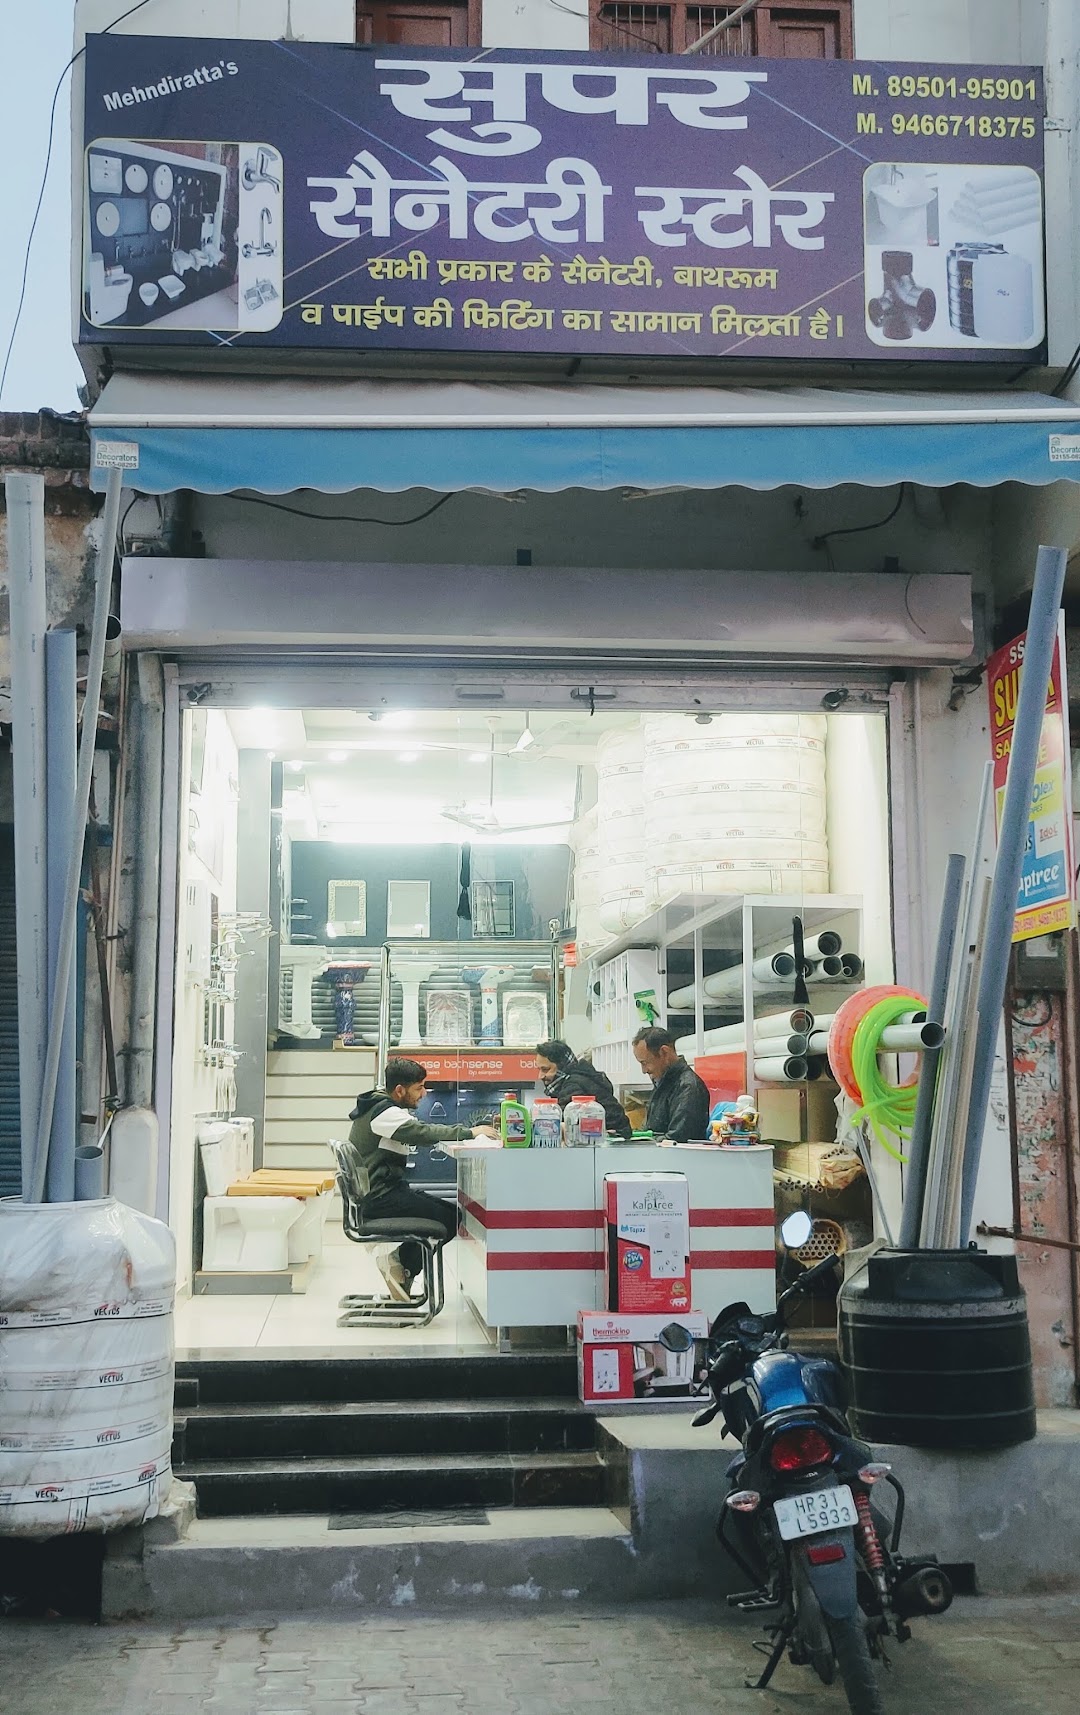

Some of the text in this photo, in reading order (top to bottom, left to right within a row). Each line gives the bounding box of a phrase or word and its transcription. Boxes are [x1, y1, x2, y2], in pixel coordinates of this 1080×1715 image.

[103, 60, 240, 112] Mehndiratta's
[852, 74, 1037, 101] M. 89501-95901
[374, 59, 768, 157] सुपर
[856, 112, 1036, 138] M. 9466718375
[306, 149, 836, 251] सैनेटरी स्टोर
[367, 250, 779, 290] सभी प्रकार के सैनेटरी, बाथरूम
[301, 303, 323, 325] व
[331, 296, 405, 330] पाईप
[413, 297, 454, 328] की
[463, 299, 555, 331] फिटिंग
[562, 309, 602, 331] का
[610, 310, 703, 334] सामान
[710, 304, 801, 337] मिलता
[96, 452, 138, 461] Decorators
[444, 1059, 503, 1069] bathsense
[93, 1306, 120, 1317] VECTUS
[99, 1373, 124, 1384] VECTUS
[96, 1431, 121, 1443] VECTUS
[796, 1507, 851, 1533] L5933
